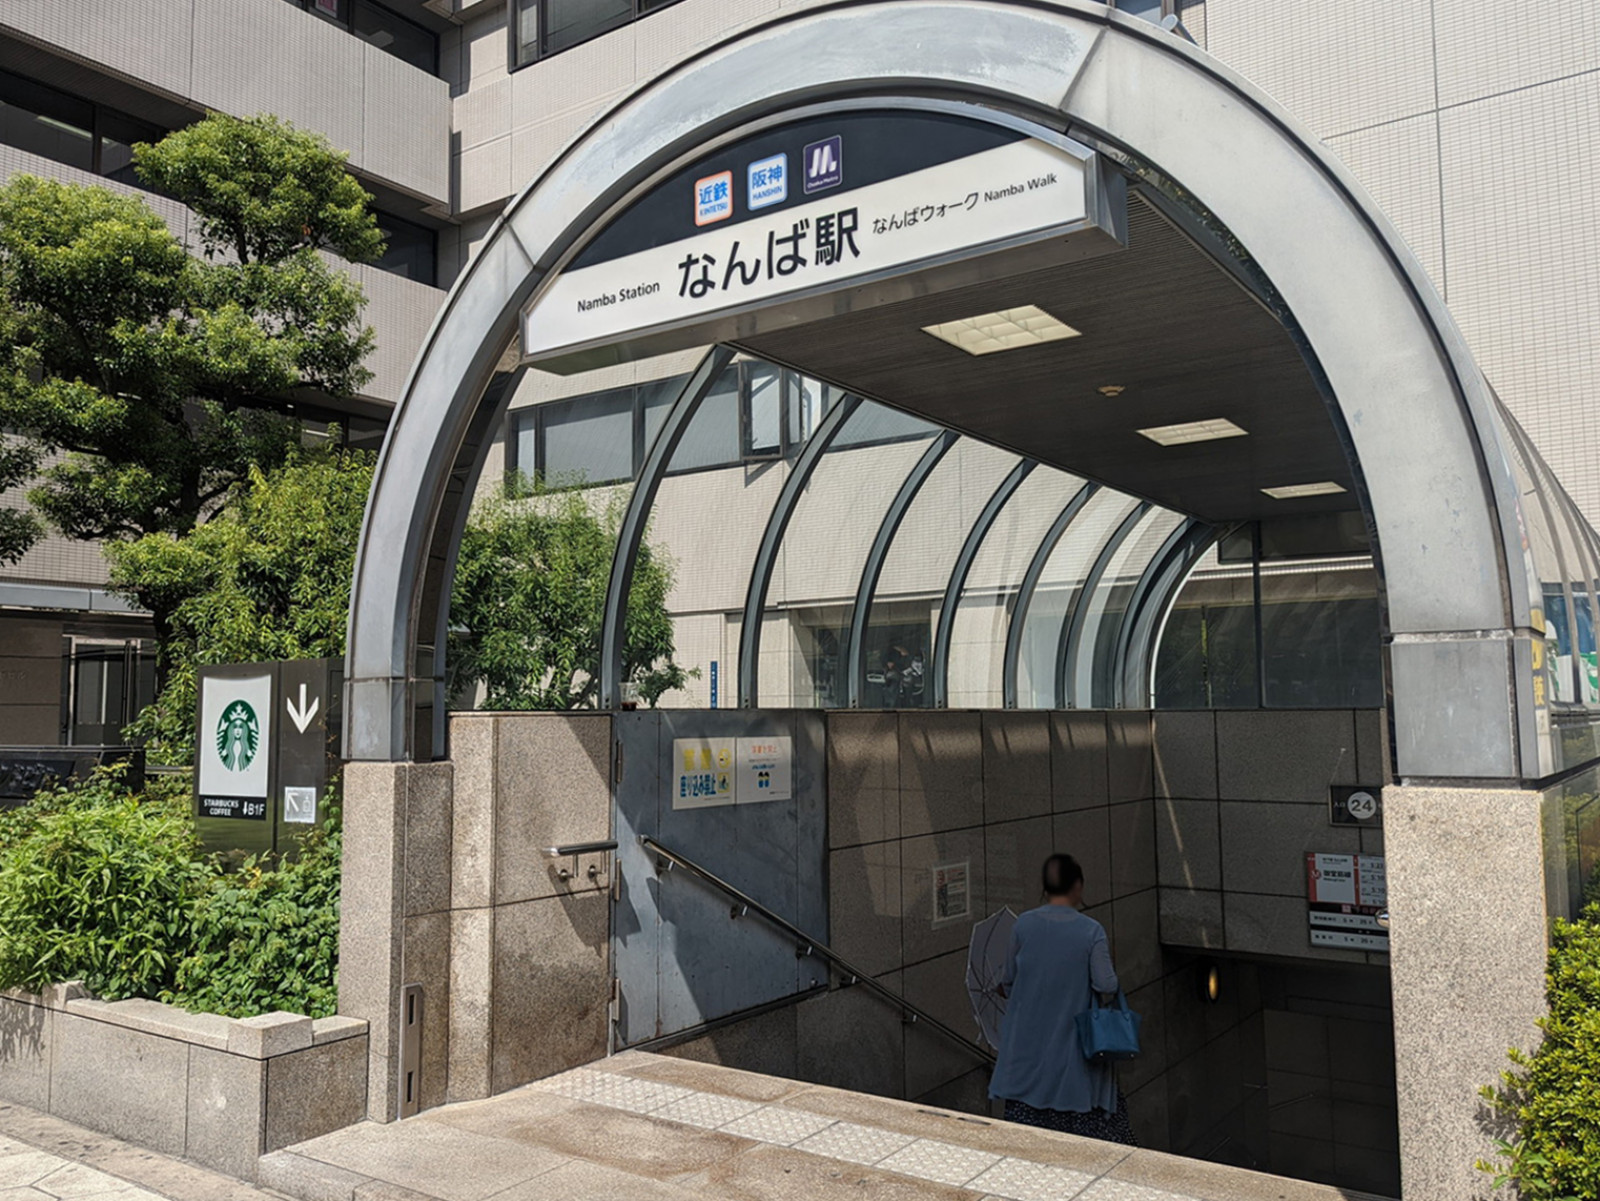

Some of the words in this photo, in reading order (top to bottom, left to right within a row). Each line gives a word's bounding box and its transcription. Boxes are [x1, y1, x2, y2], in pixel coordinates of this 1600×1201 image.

[751, 164, 783, 190] 阪神
[984, 184, 1025, 203] Namba
[1027, 172, 1058, 191] Walk
[699, 182, 729, 205] 近鉄
[752, 185, 783, 201] HANSHIN
[872, 192, 980, 235] なんばウォーク
[678, 207, 861, 299] なんば駅
[577, 293, 617, 313] Namba
[619, 281, 660, 302] Station
[203, 799, 239, 808] STARBUCKS
[248, 804, 265, 815] B1F
[1351, 799, 1373, 812] 24
